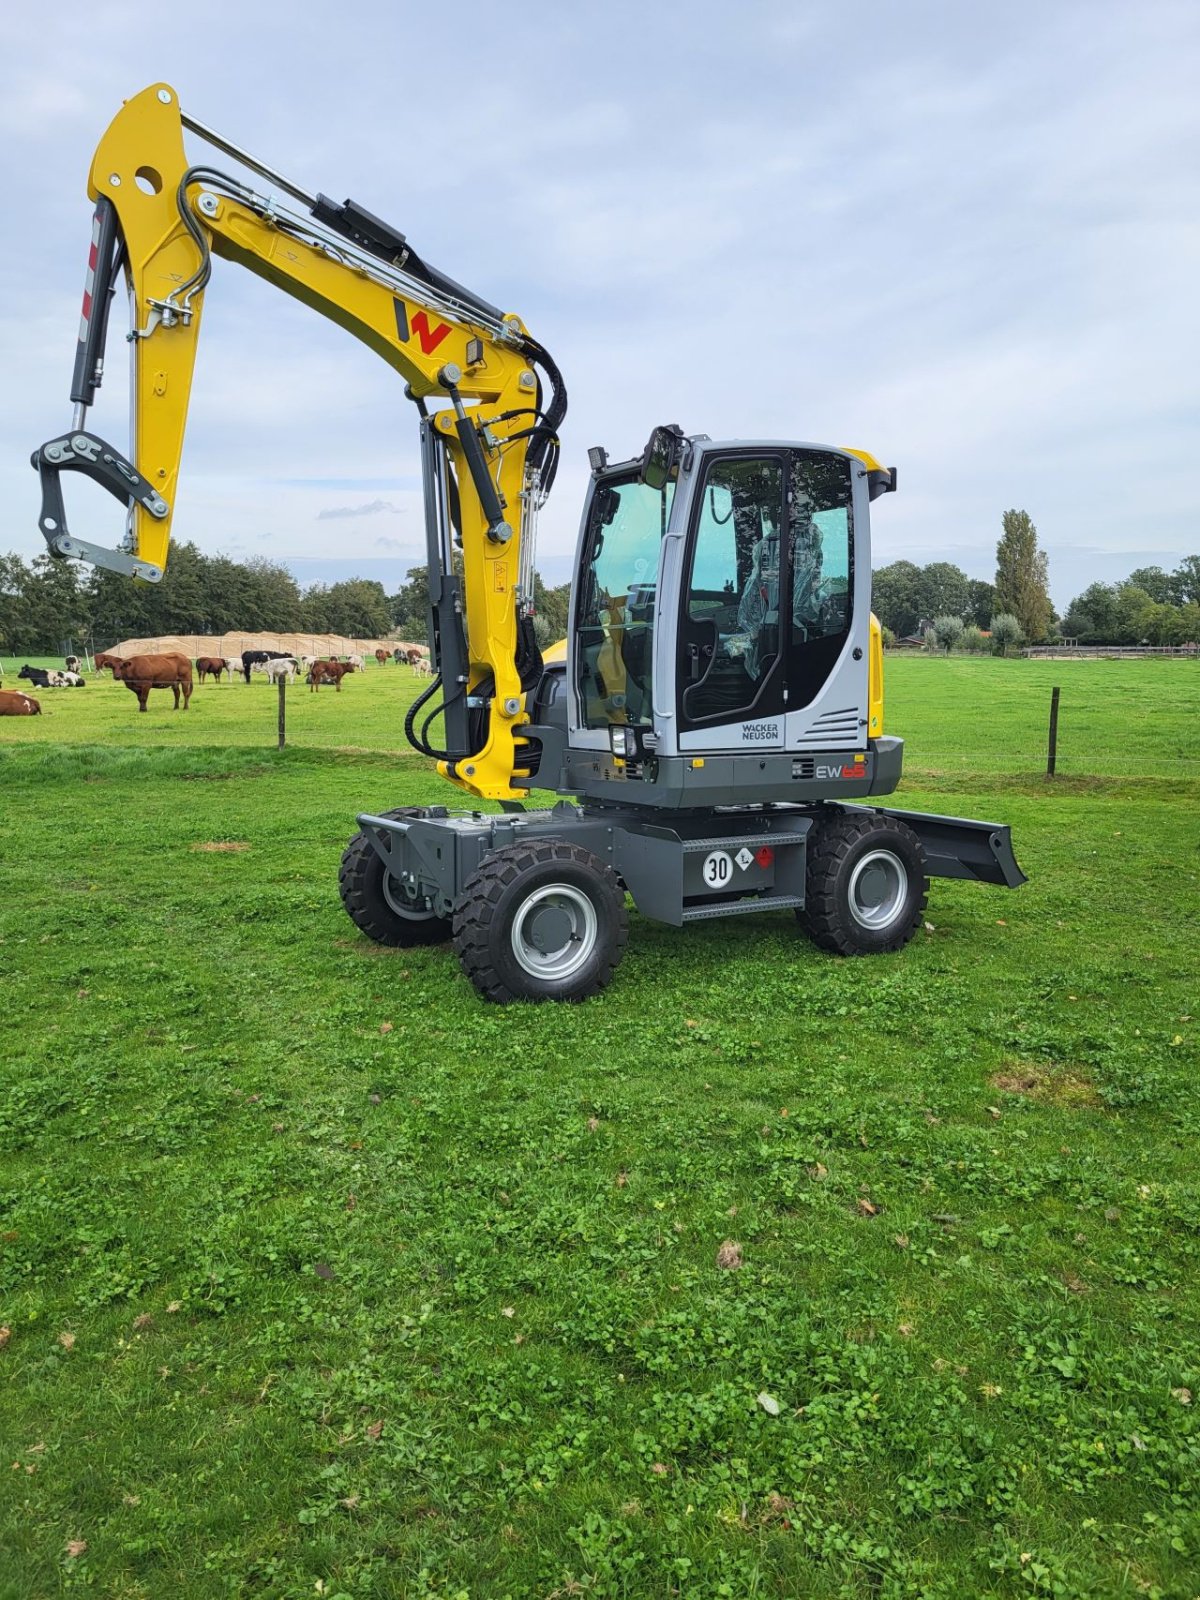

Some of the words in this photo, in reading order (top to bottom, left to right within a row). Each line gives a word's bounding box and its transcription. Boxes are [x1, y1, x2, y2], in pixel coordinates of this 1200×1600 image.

[742, 724, 778, 732] WACKER
[742, 732, 778, 740] NEUSON
[816, 764, 865, 778] EW65
[708, 857, 727, 881] 30
